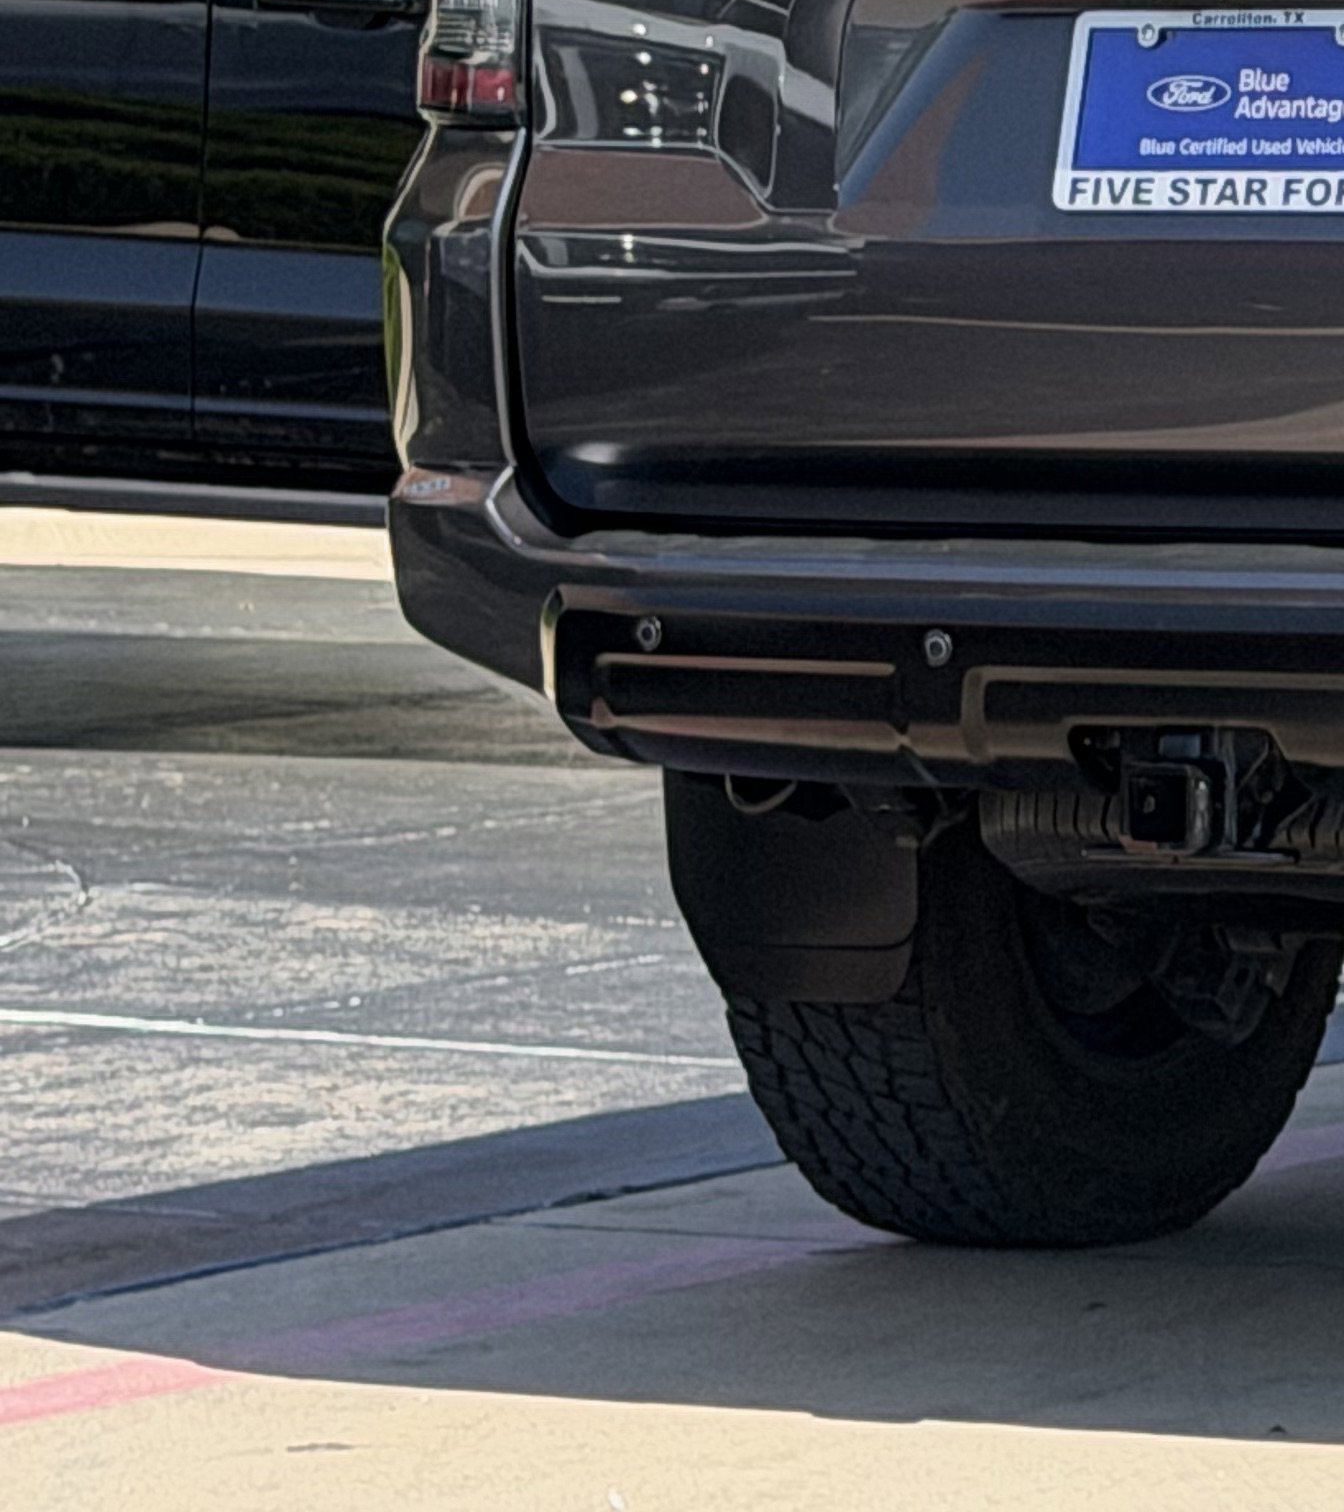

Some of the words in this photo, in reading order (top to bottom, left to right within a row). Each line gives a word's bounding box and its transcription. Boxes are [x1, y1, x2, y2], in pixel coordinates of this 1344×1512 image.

[1283, 11, 1305, 24] TX
[1238, 67, 1291, 93] Blue
[1139, 138, 1176, 156] Blue
[1179, 138, 1248, 156] Certified
[1251, 138, 1292, 156] Used
[1068, 177, 1157, 206] FIVE
[1167, 177, 1269, 206] STAR
